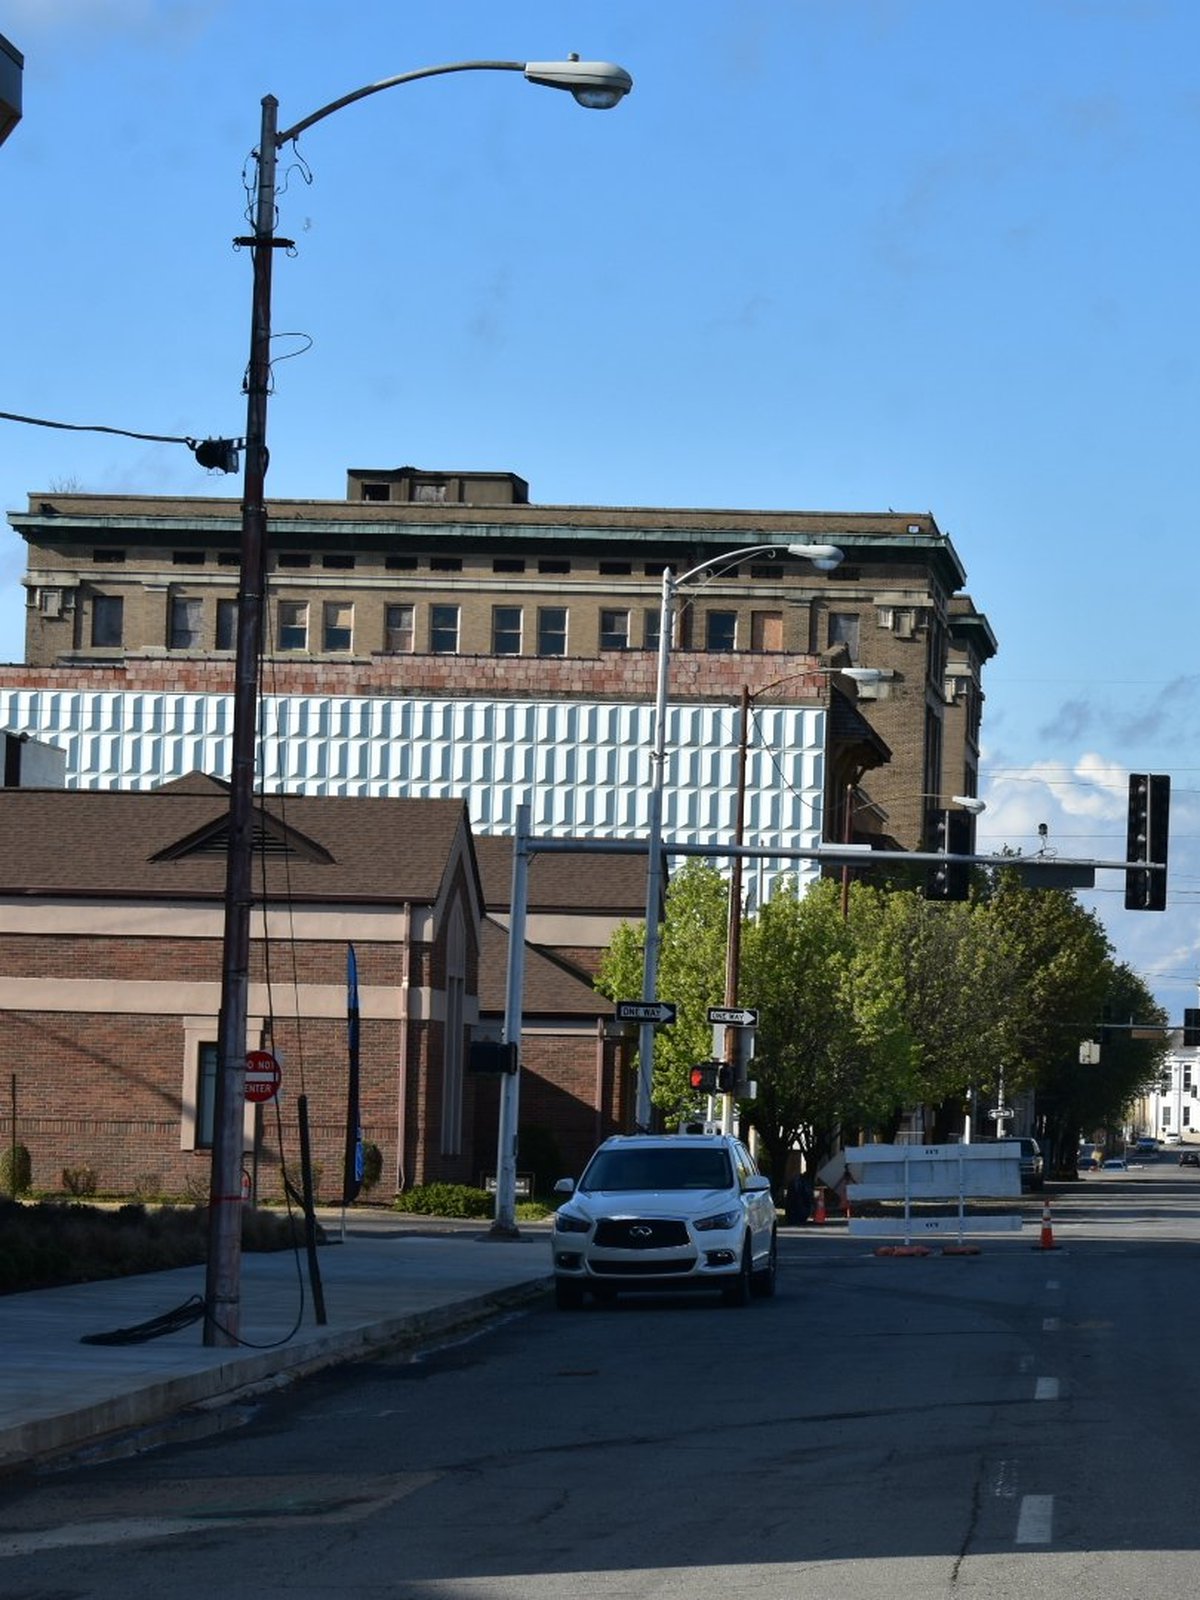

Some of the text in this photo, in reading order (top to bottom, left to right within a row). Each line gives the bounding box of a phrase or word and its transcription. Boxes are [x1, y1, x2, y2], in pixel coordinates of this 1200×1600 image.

[623, 1006, 661, 1017] ONE WAY
[711, 1011, 745, 1021] ONE WAY
[244, 1083, 271, 1093] ENTER
